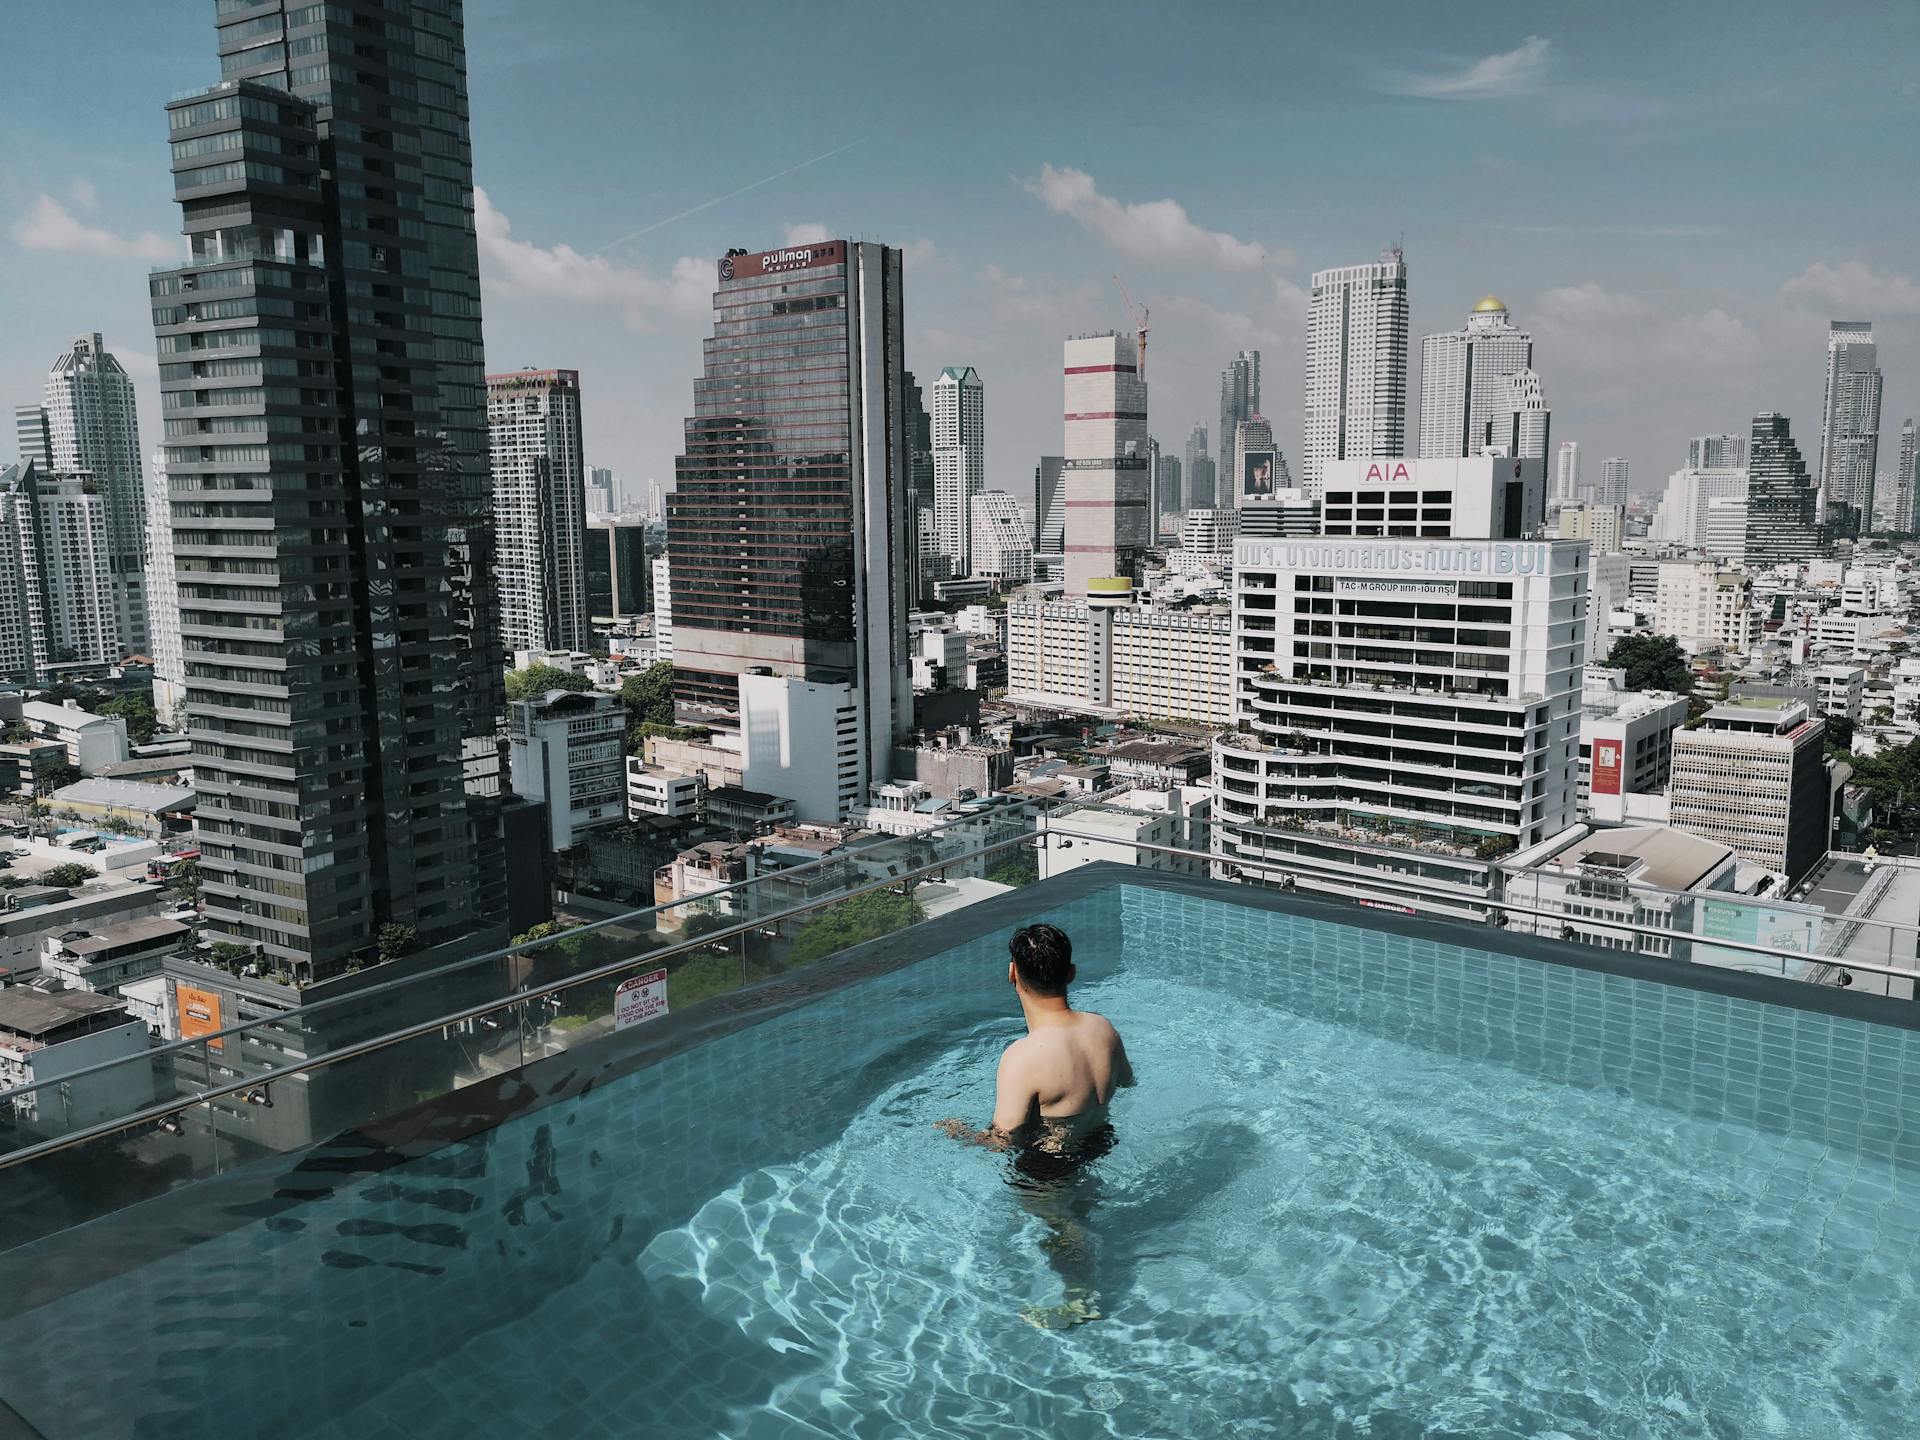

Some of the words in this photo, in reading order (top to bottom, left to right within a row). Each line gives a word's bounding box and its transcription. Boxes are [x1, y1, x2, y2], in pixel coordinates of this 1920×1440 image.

[763, 249, 811, 269] pullman
[768, 261, 807, 272] HOTELS
[1365, 463, 1410, 481] AIA
[1494, 544, 1546, 575] BUI
[1369, 583, 1398, 592] GROUP
[628, 973, 659, 989] DANGER
[617, 1010, 634, 1021] STAND
[635, 1007, 644, 1015] ON
[645, 1003, 655, 1011] THE
[621, 1005, 630, 1013] DO
[631, 1001, 642, 1011] NOT
[624, 1016, 633, 1024] OF
[633, 1013, 643, 1021] THE
